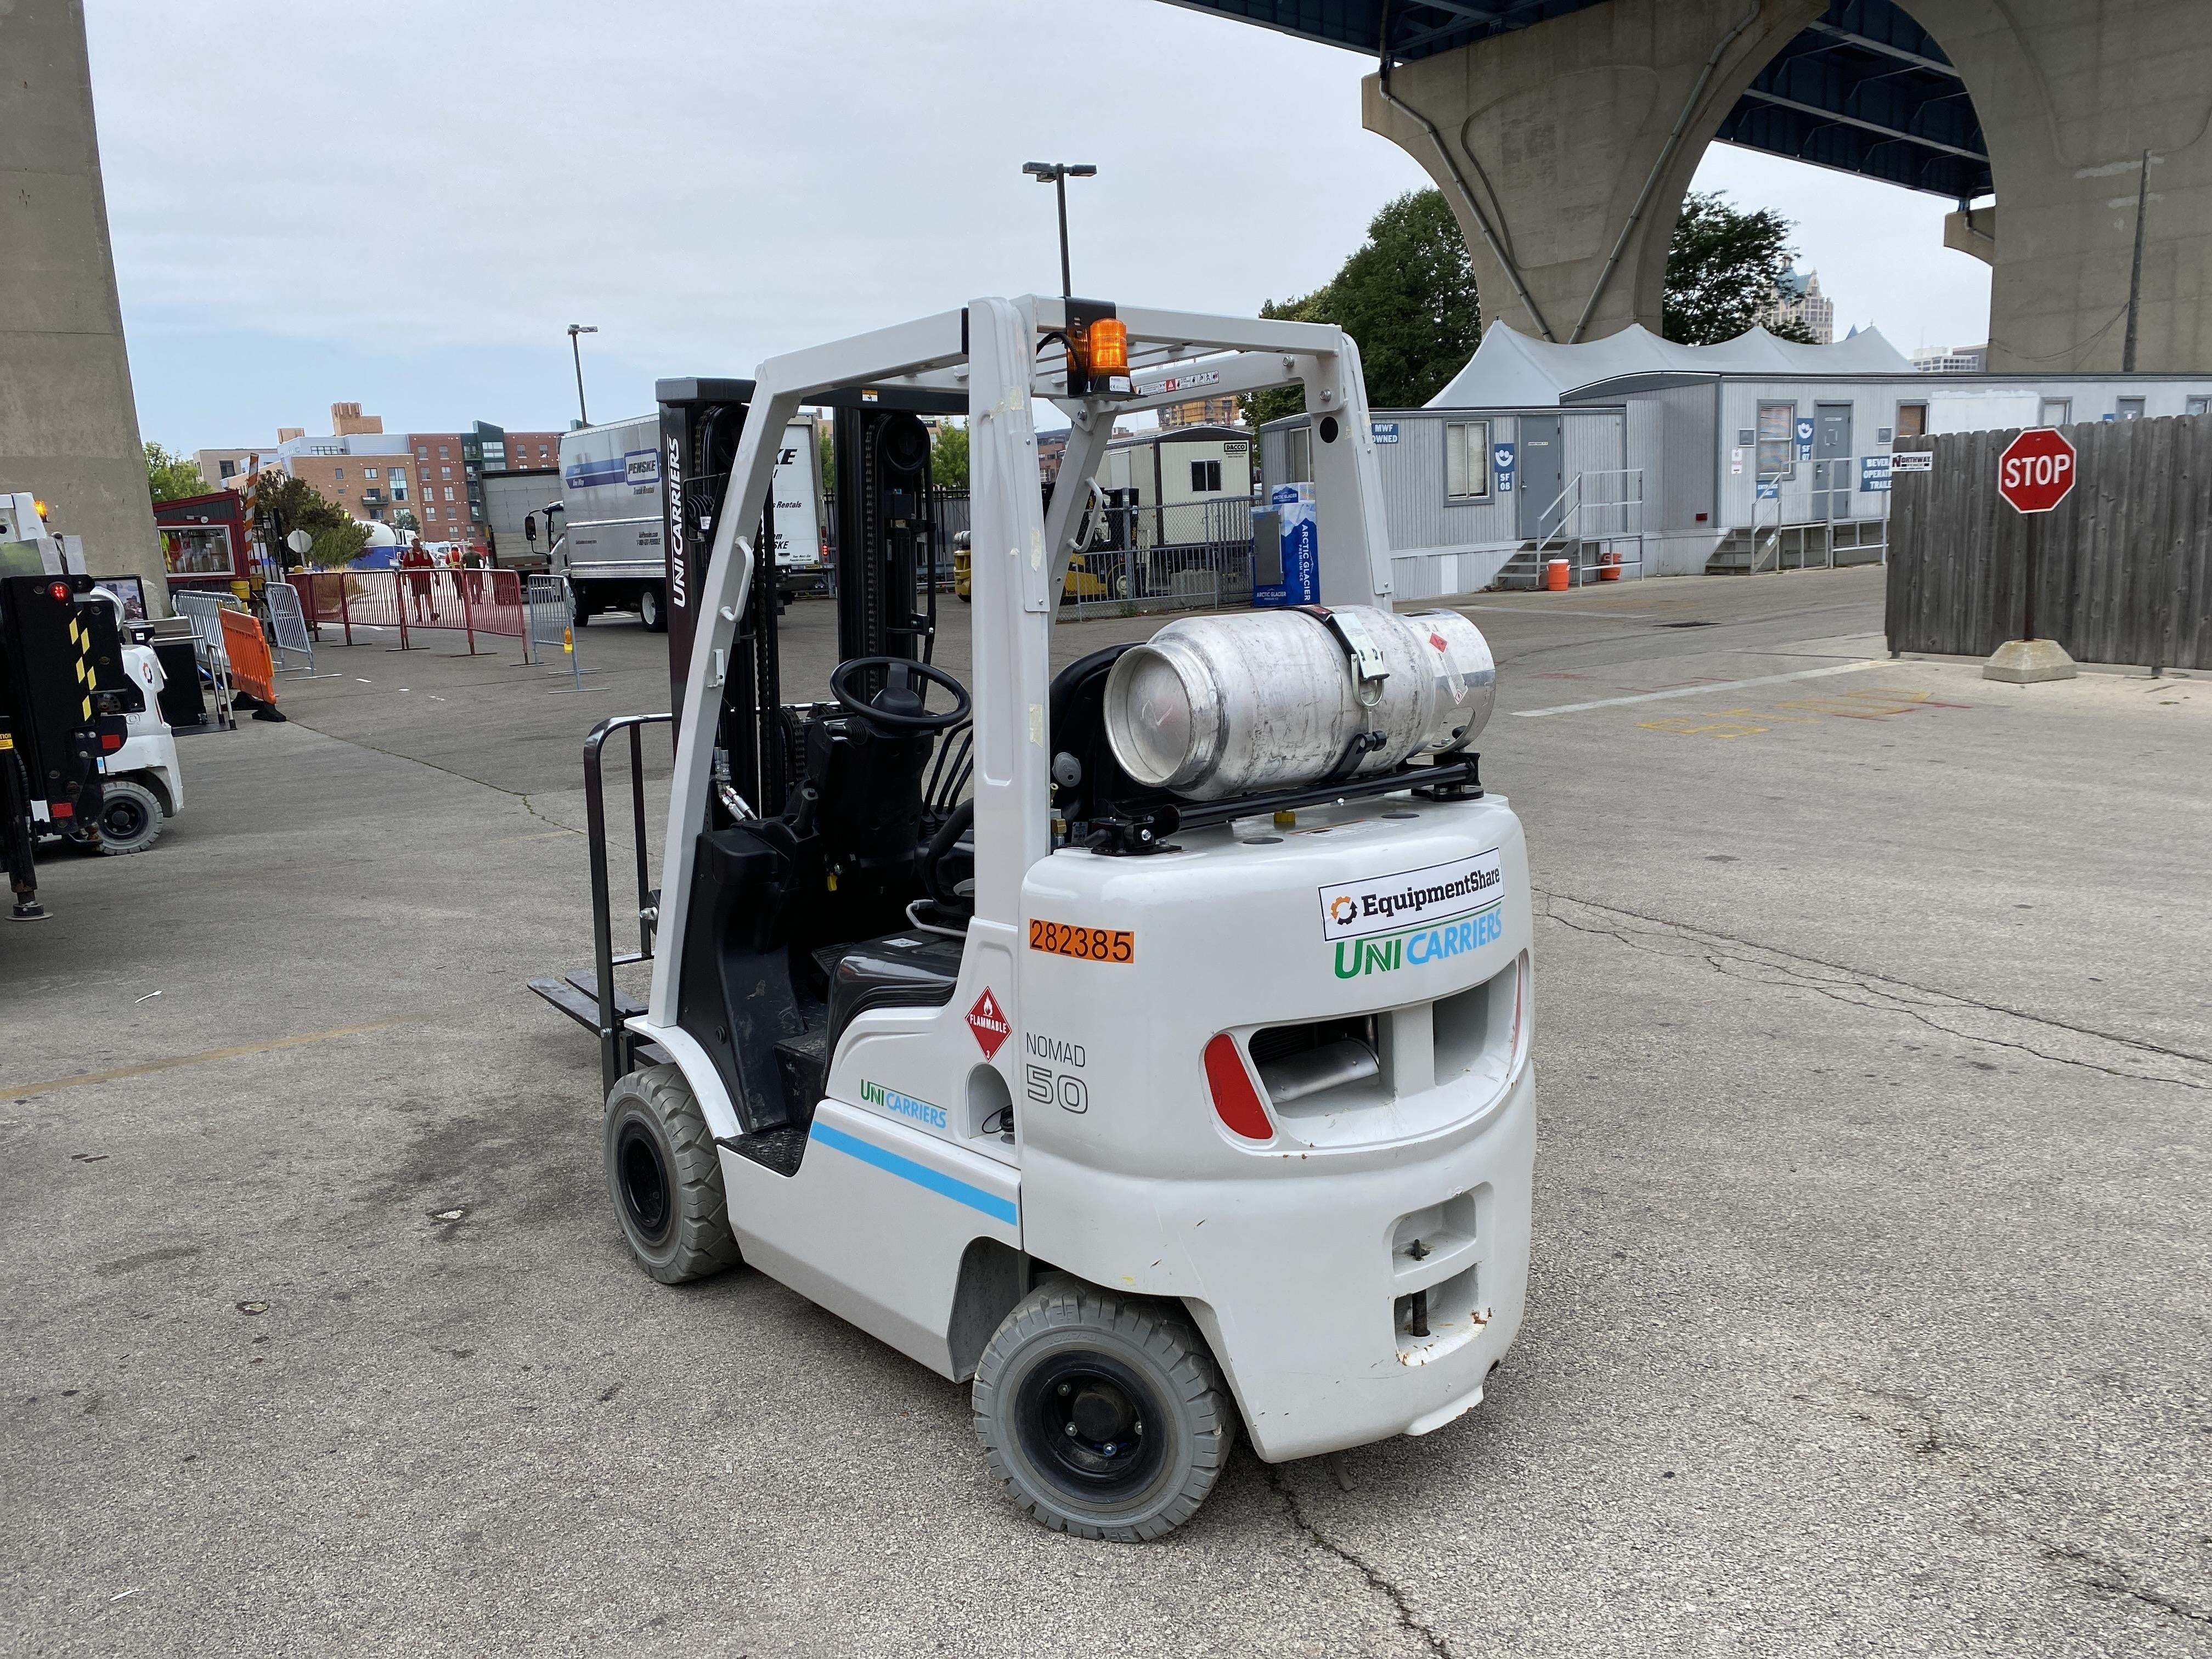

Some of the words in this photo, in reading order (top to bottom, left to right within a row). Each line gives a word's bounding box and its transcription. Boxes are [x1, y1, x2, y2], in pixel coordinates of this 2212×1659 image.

[1372, 435, 1398, 443] OWNED
[628, 460, 656, 475] PENSKE
[1500, 473, 1510, 481] SF
[2005, 454, 2070, 488] STOP
[1500, 482, 1510, 490] 08
[1361, 867, 1499, 917] EquipmentShare
[1031, 920, 1131, 961] 282385
[970, 1014, 1007, 1034] FLAMMABLE
[986, 1050, 990, 1059] 3
[1026, 1032, 1085, 1067] NOMAD
[1026, 1063, 1088, 1114] 50
